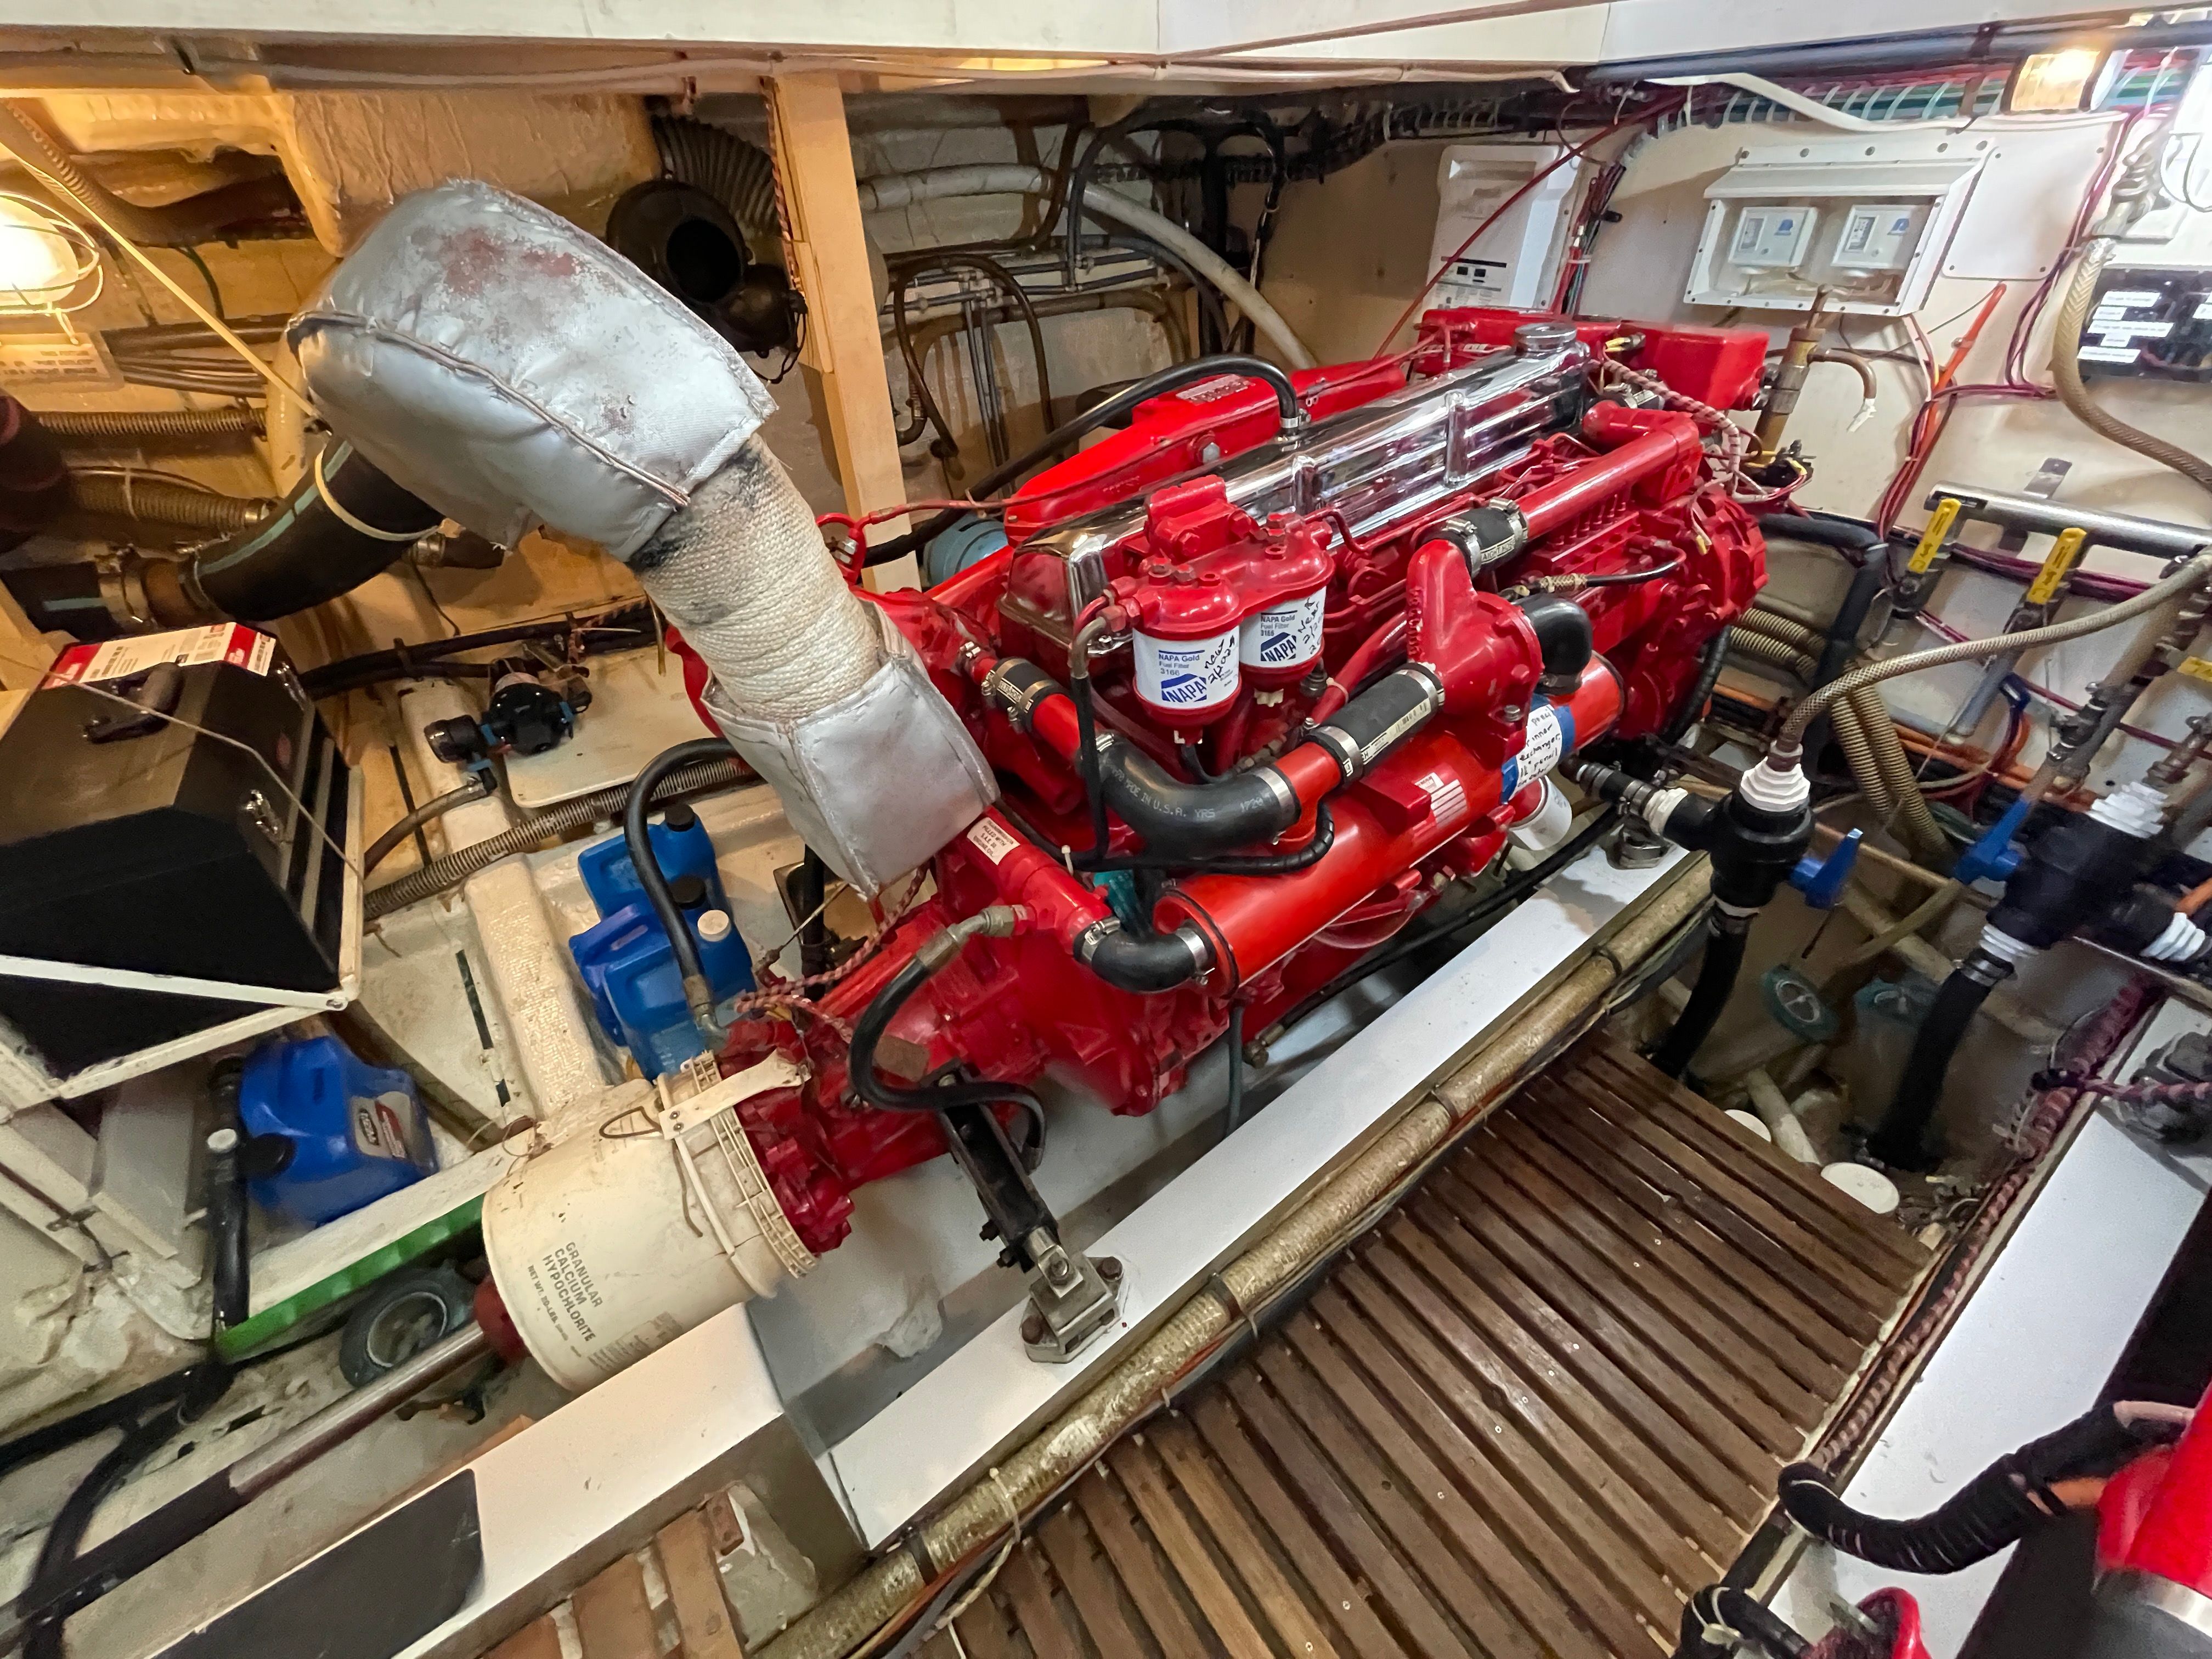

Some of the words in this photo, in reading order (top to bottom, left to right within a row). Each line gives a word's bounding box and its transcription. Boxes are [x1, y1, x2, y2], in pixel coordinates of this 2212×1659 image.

[1481, 546, 1500, 560] AIGHT
[1158, 653, 1180, 662] NAPA
[1263, 639, 1296, 662] NAPA
[1164, 680, 1207, 703] NAPA
[1125, 778, 1141, 797] MADE
[1141, 792, 1152, 805] IN
[1153, 800, 1187, 817] U.S.A.
[527, 1264, 539, 1280] NET
[555, 1248, 588, 1305] CALCIUM
[566, 1242, 603, 1308] GRANULAR
[542, 1254, 596, 1342] HYPOCHLORITE
